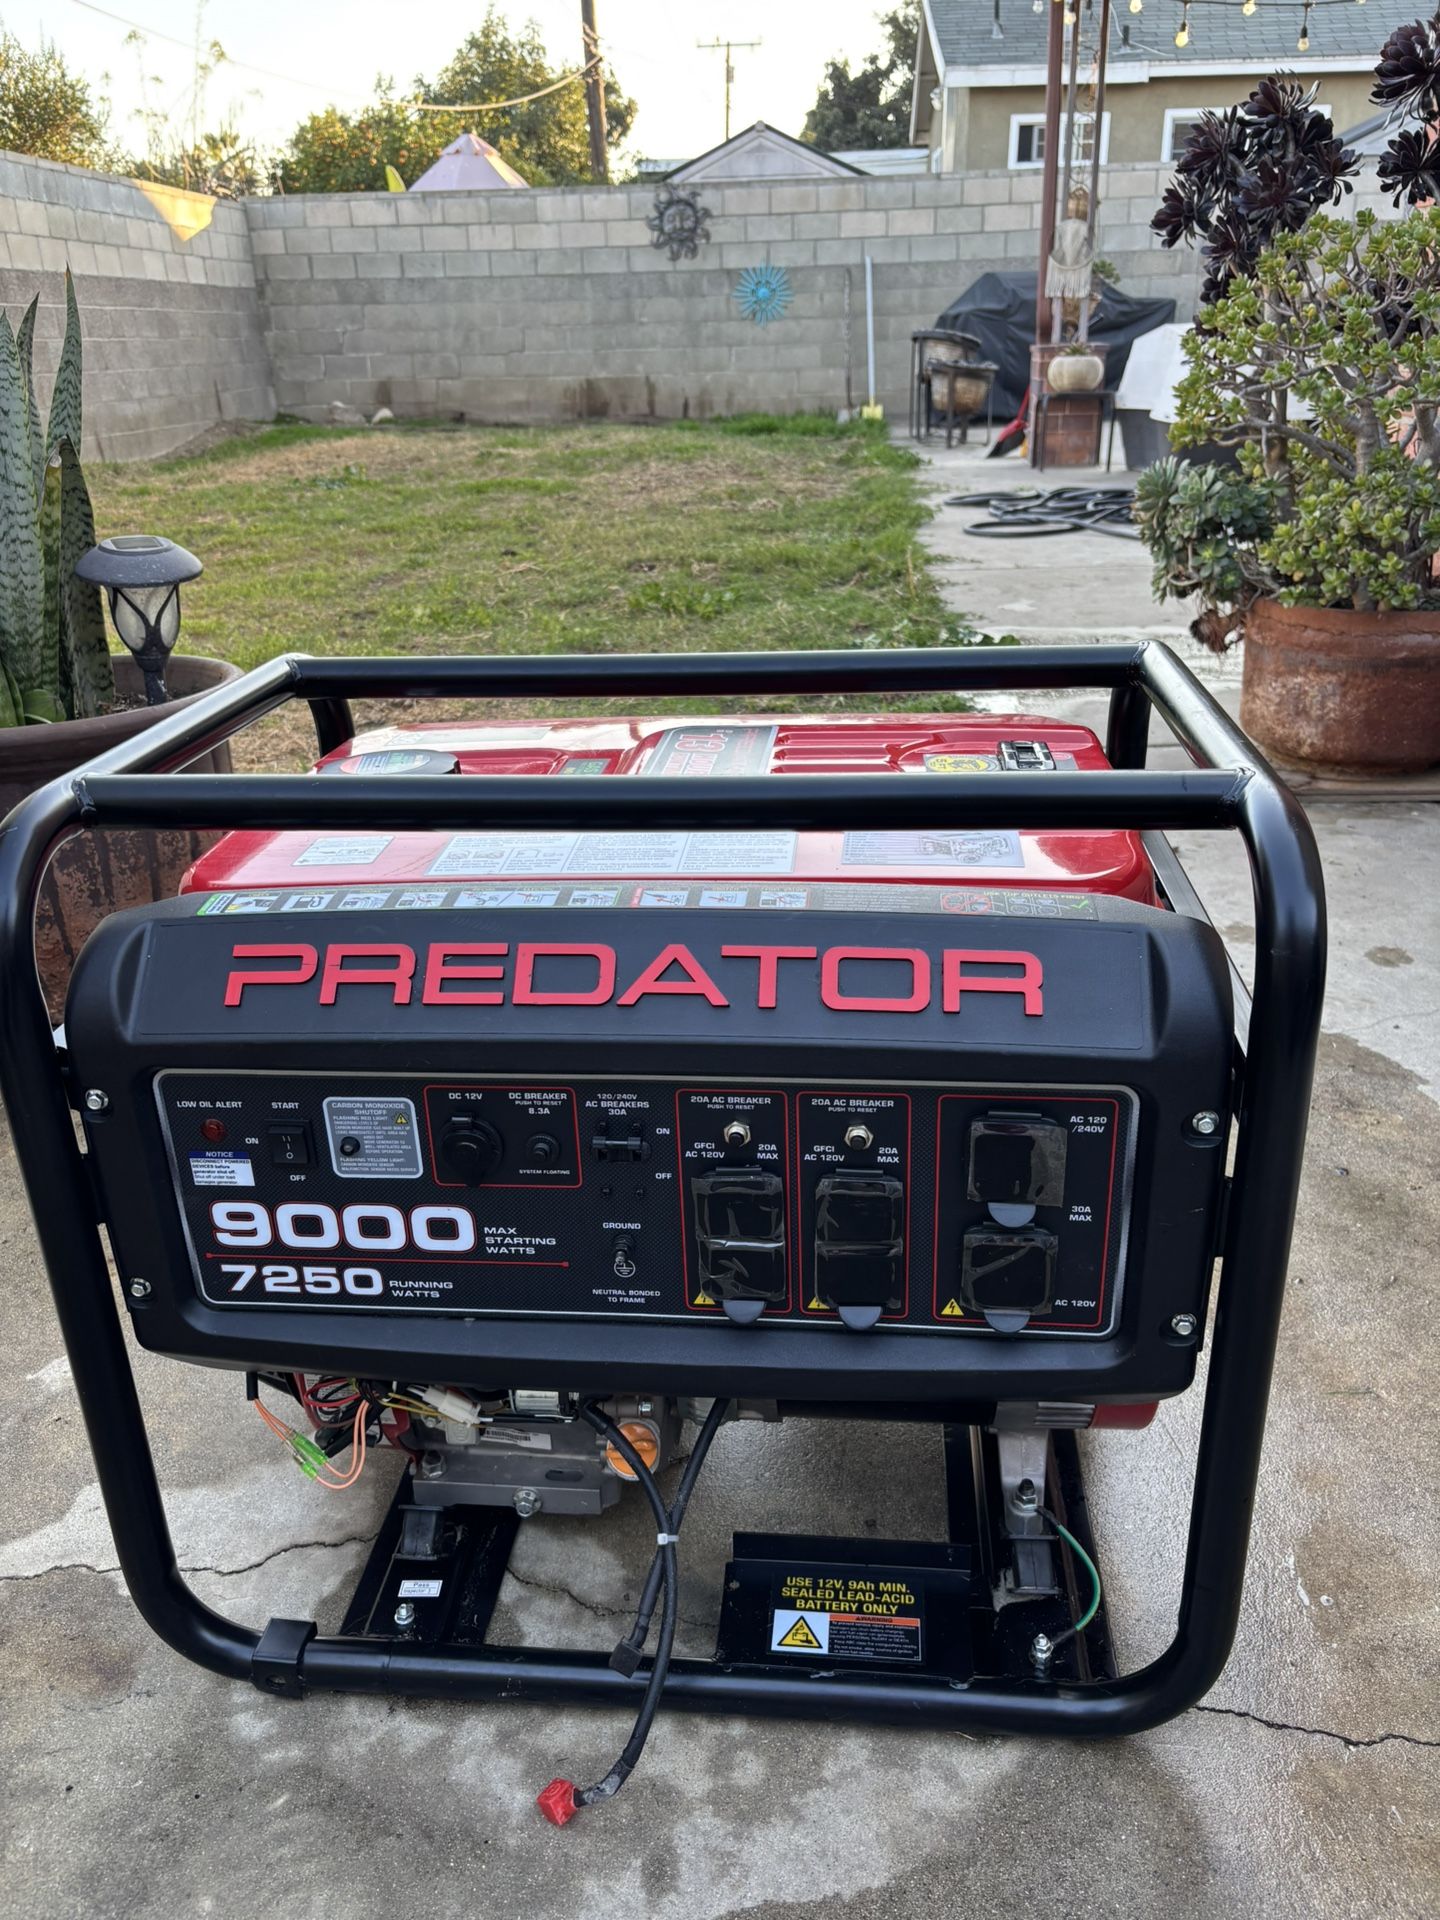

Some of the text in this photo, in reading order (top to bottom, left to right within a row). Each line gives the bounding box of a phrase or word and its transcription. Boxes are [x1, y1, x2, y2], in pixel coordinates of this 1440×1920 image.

[224, 942, 1045, 1018] PREDATOR
[1087, 1116, 1107, 1124] 120
[656, 1127, 670, 1135] ON
[1071, 1125, 1105, 1133] /240V
[813, 1145, 835, 1153] GFCI
[700, 1151, 725, 1159] 120V
[757, 1152, 779, 1160] MAX
[820, 1154, 845, 1162] 120V
[877, 1155, 899, 1163] MAX
[655, 1172, 672, 1180] OFF
[1069, 1214, 1092, 1222] MAX
[210, 1201, 476, 1252] 9000
[484, 1226, 517, 1235] MAX
[485, 1236, 556, 1245] STARTING
[486, 1246, 536, 1255] WATTS
[220, 1264, 384, 1296] 7250
[389, 1280, 453, 1289] RUNNING
[391, 1289, 440, 1298] WATTS
[1071, 1300, 1096, 1308] 120V
[786, 1576, 911, 1593] USE 12V, 9Ah MIN.
[781, 1587, 915, 1605] SEALED LEAD-ACID
[796, 1599, 899, 1615] BATTERY ONLY
